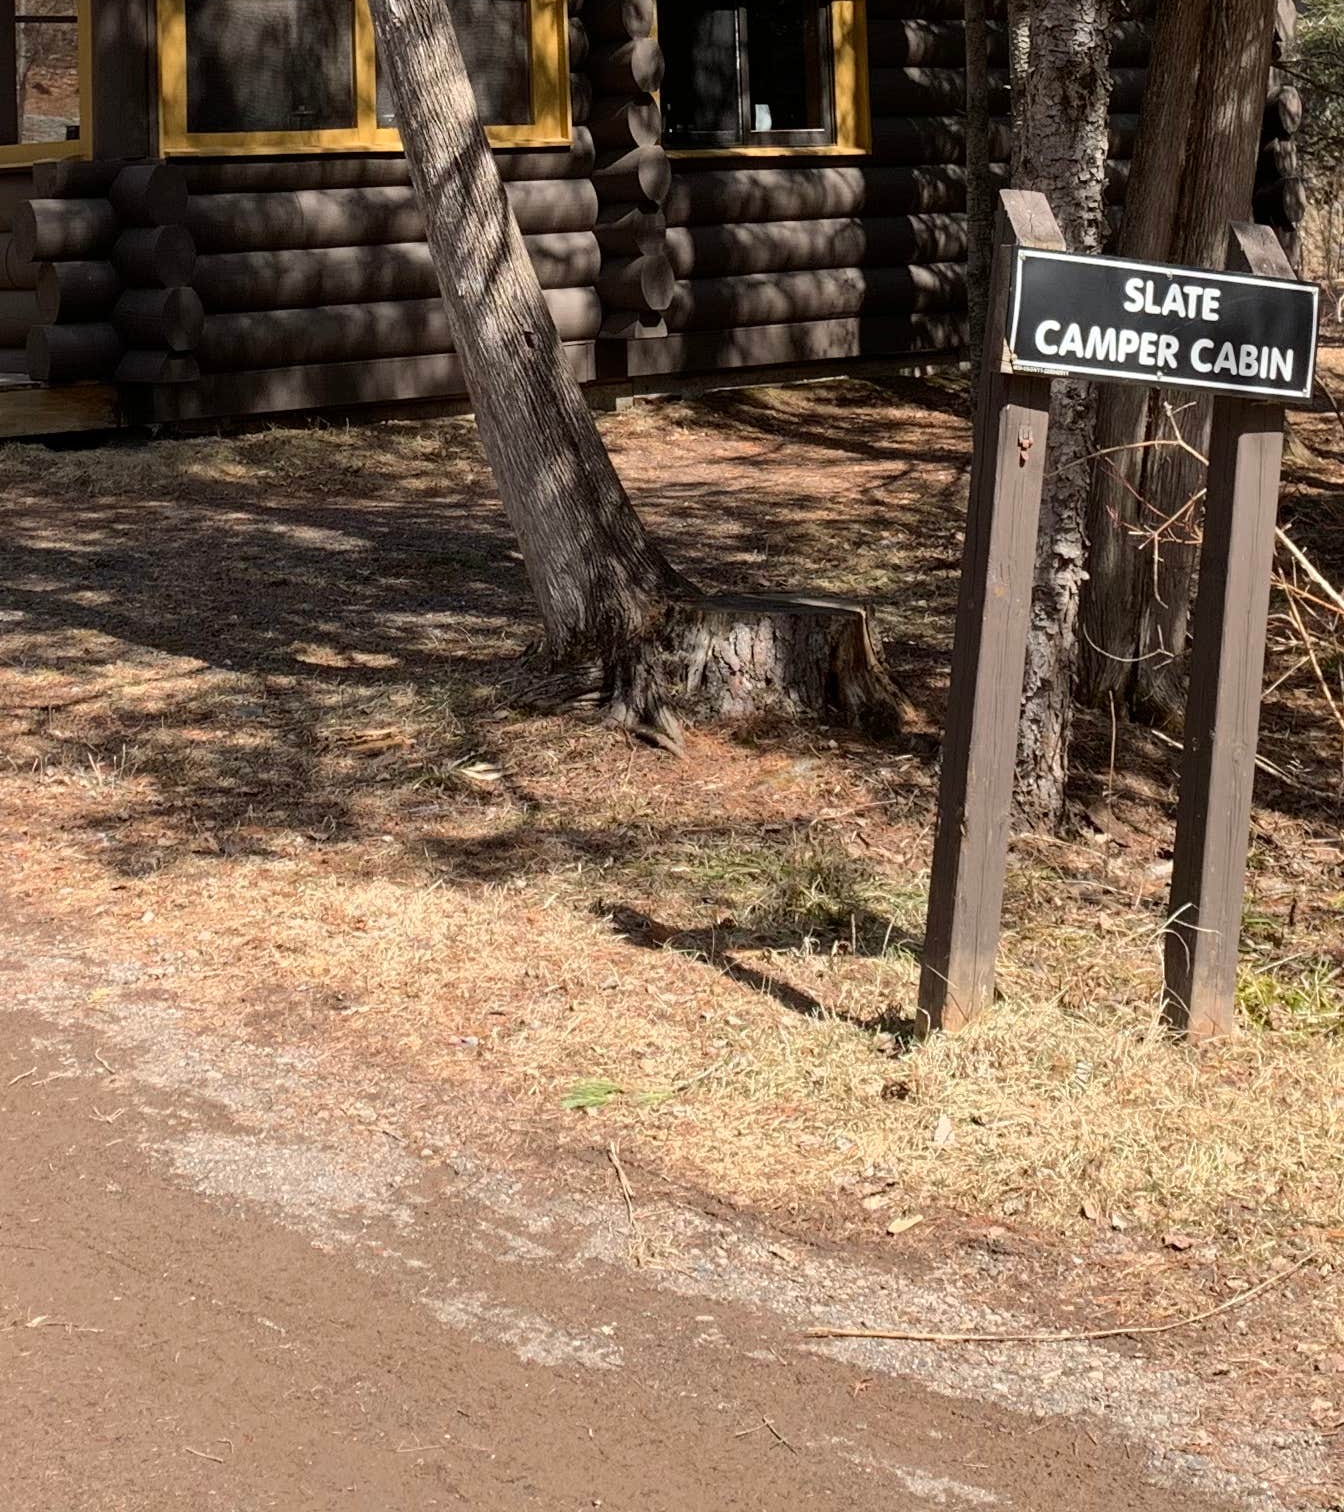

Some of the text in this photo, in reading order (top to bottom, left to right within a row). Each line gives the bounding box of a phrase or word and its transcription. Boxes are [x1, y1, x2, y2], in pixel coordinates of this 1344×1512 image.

[1123, 277, 1221, 322] SLATE
[1034, 319, 1294, 382] CAMPER CABIN
